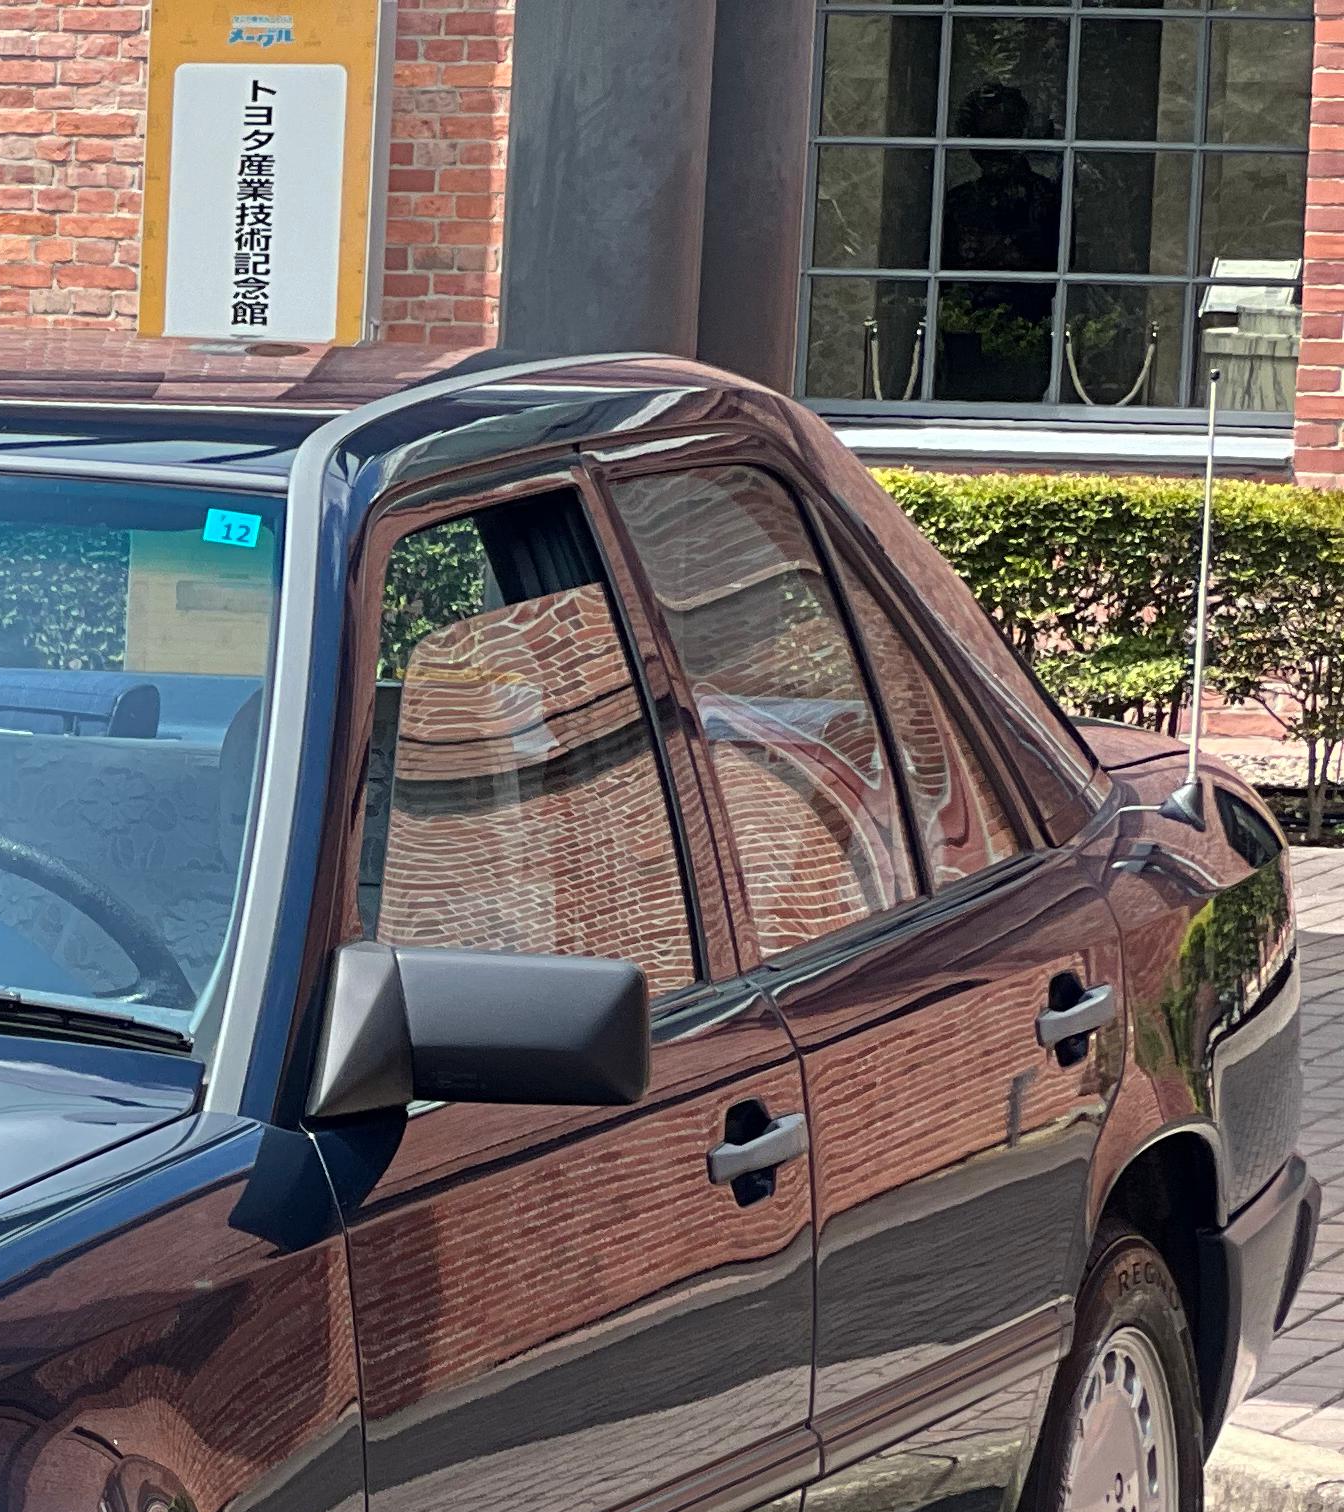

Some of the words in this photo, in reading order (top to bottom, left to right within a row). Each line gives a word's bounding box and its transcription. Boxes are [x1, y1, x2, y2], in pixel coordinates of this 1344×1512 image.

[231, 80, 277, 327] トヨタ産業技術記念館
[222, 523, 251, 543] 12
